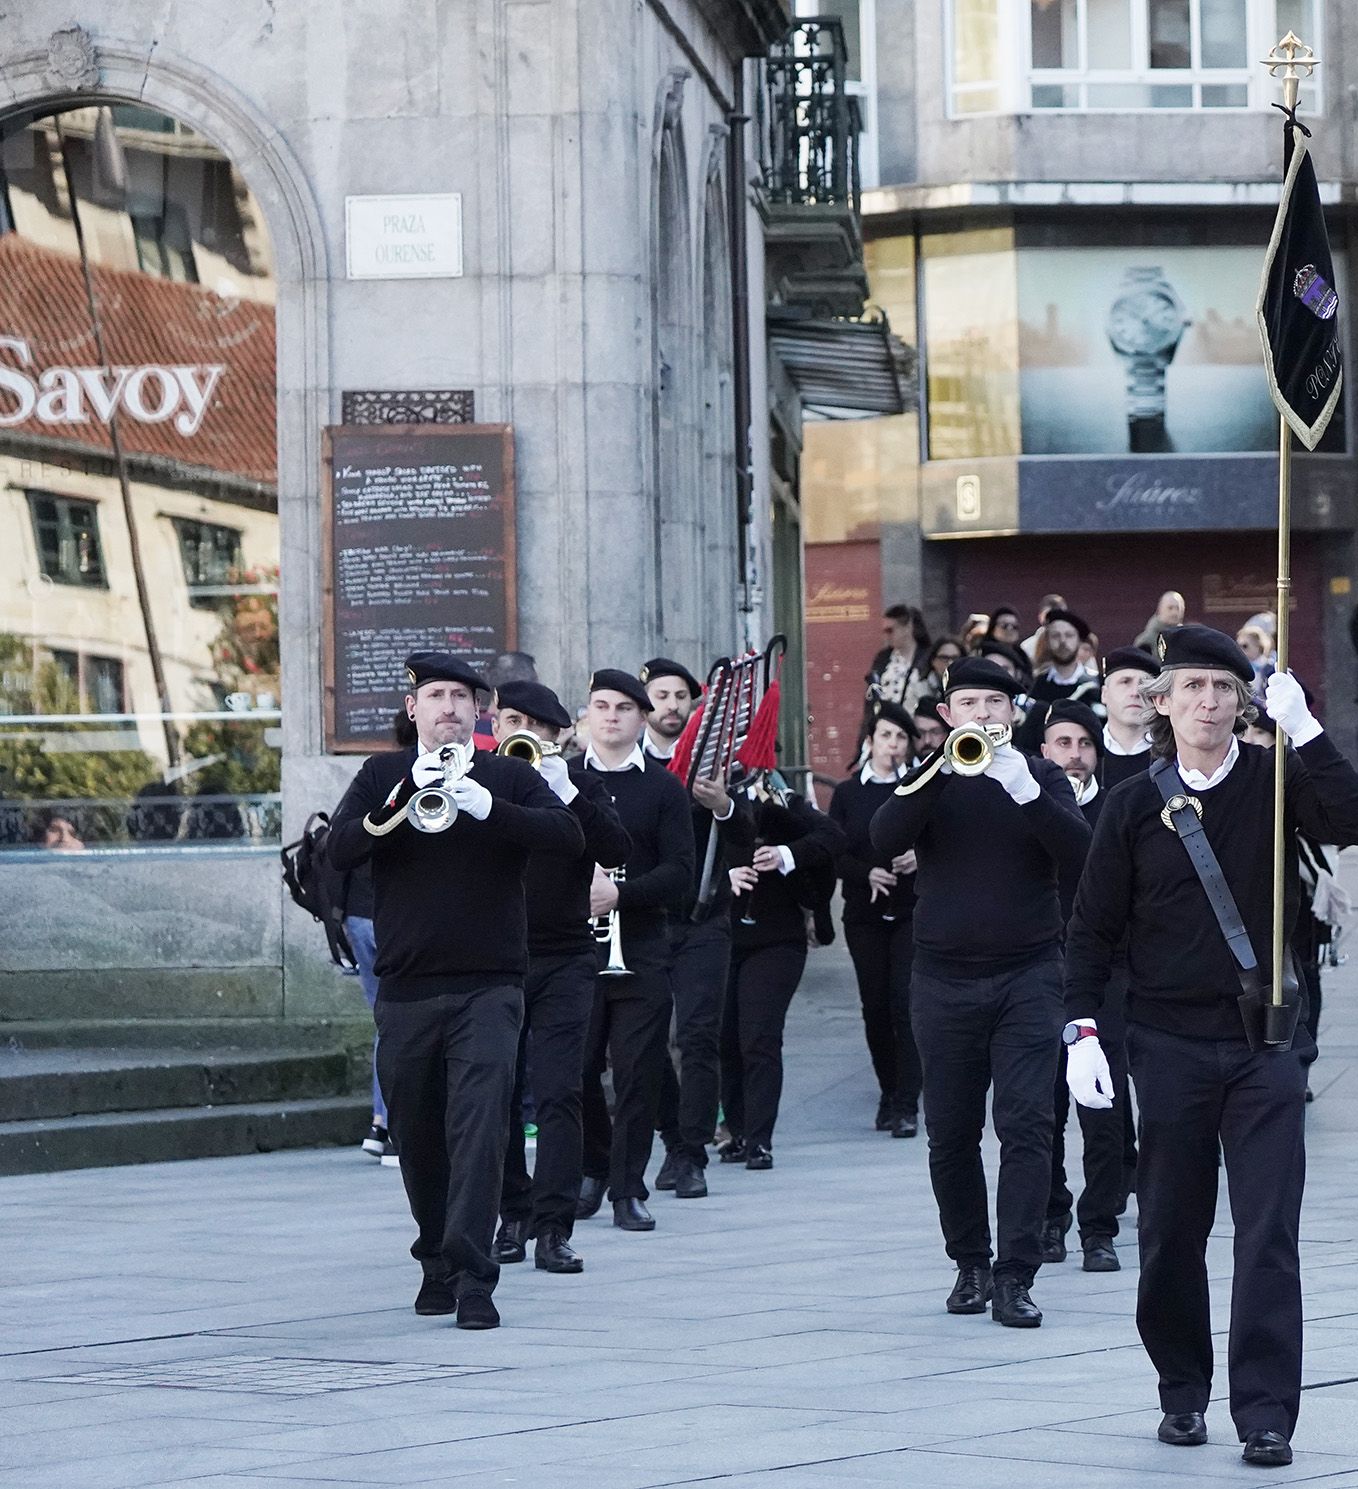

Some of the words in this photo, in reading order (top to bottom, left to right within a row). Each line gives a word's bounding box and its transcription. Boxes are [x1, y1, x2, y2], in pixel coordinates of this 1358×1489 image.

[383, 214, 426, 234] PRAZA
[375, 243, 436, 264] OURENSE
[0, 335, 225, 437] Savoy
